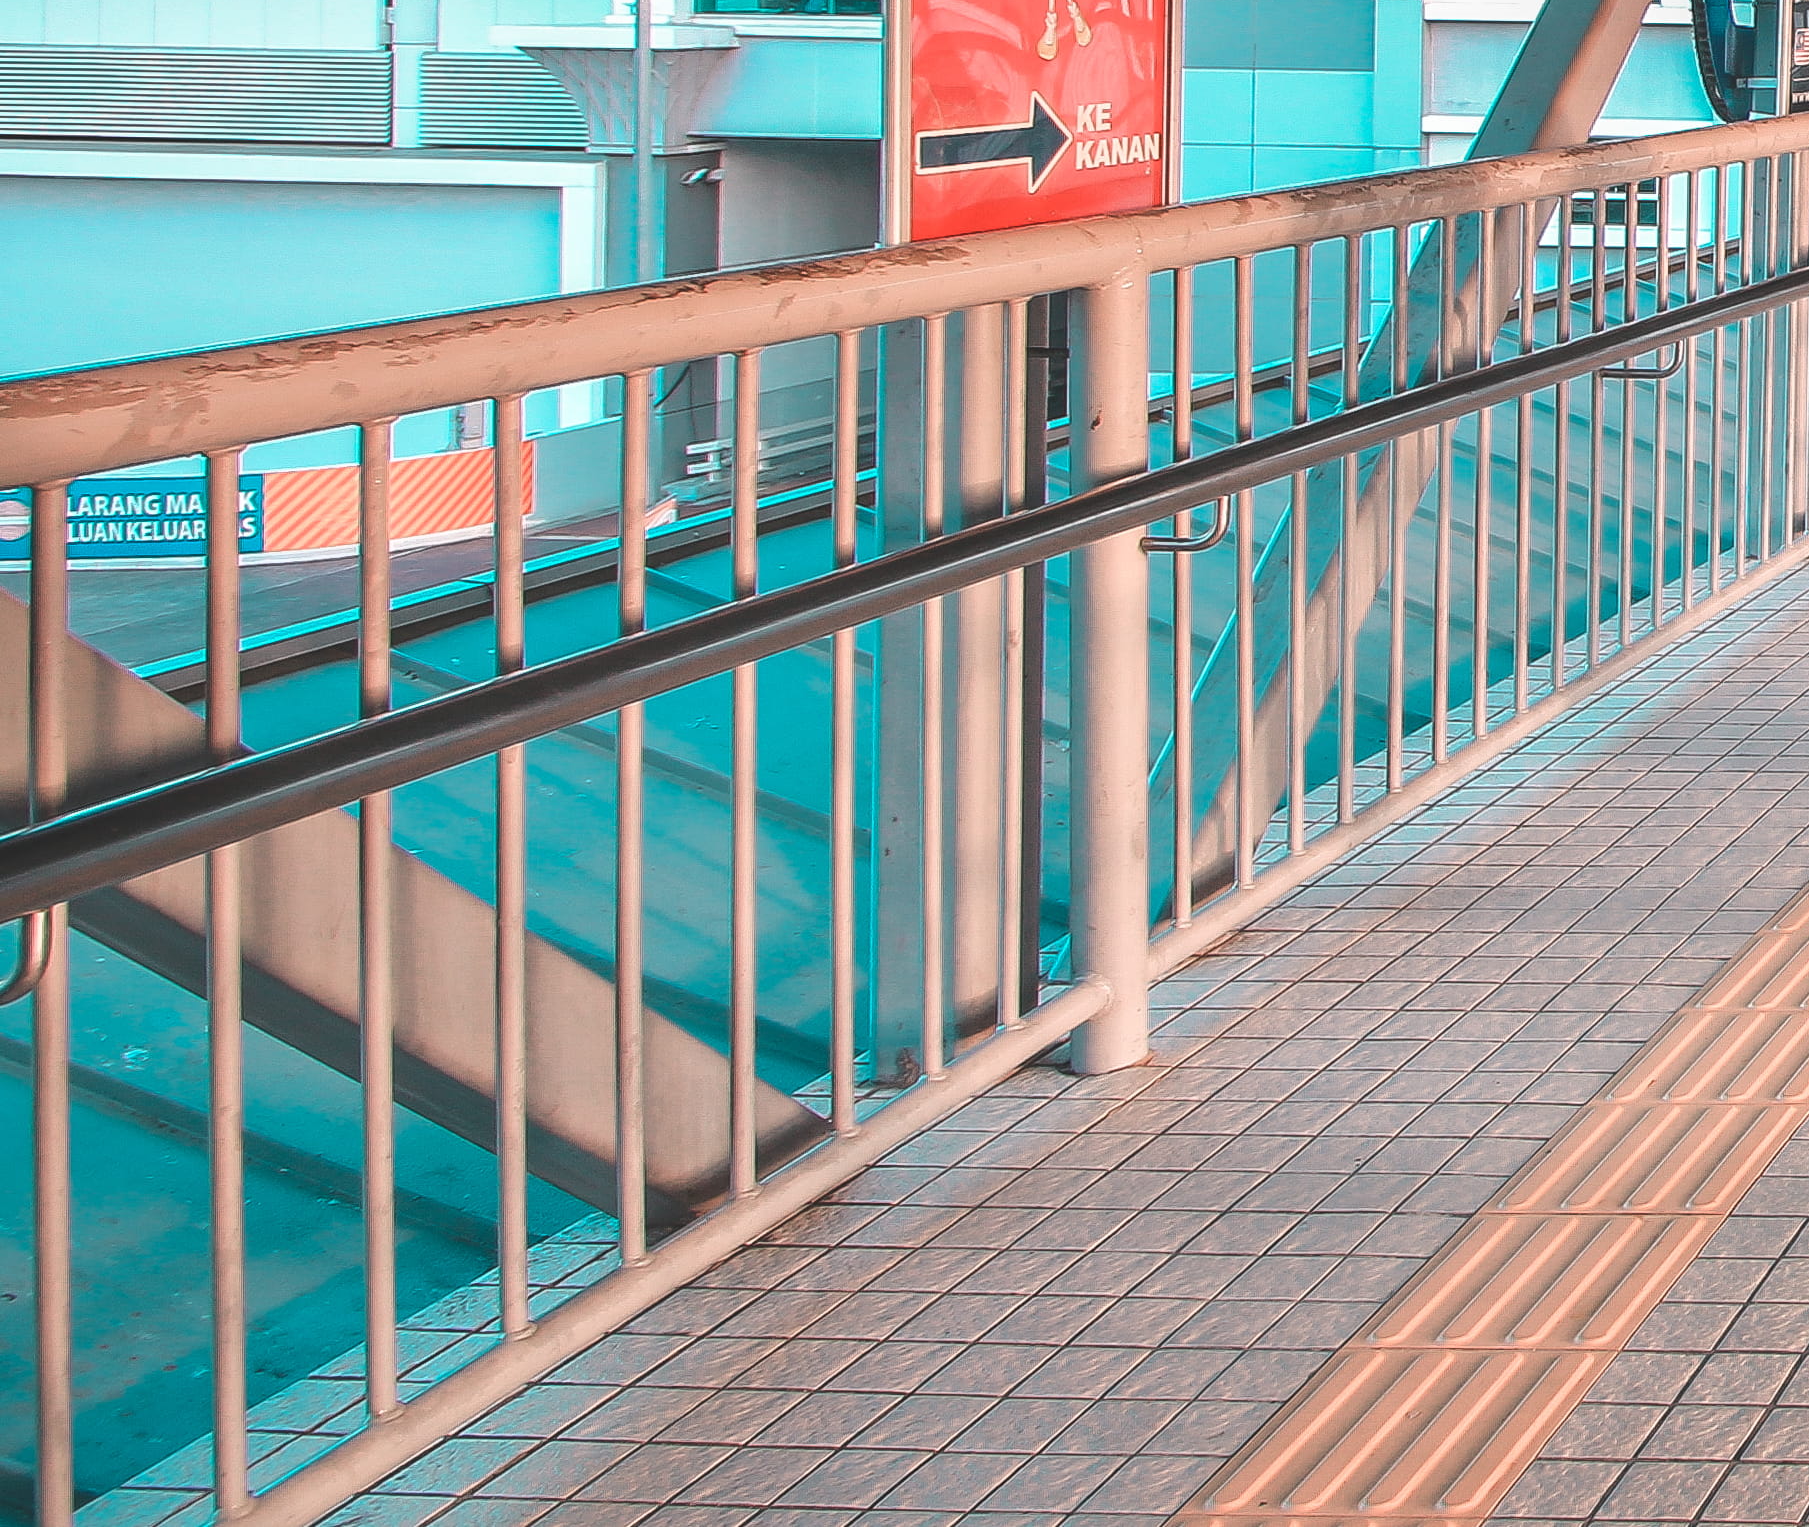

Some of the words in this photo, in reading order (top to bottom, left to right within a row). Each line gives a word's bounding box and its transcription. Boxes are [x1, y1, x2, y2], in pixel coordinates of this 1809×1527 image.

[1076, 103, 1112, 133] KE
[1075, 133, 1161, 170] KANAN
[67, 494, 161, 517] LARANG
[166, 491, 256, 517] MAK
[67, 520, 123, 543] LUAN
